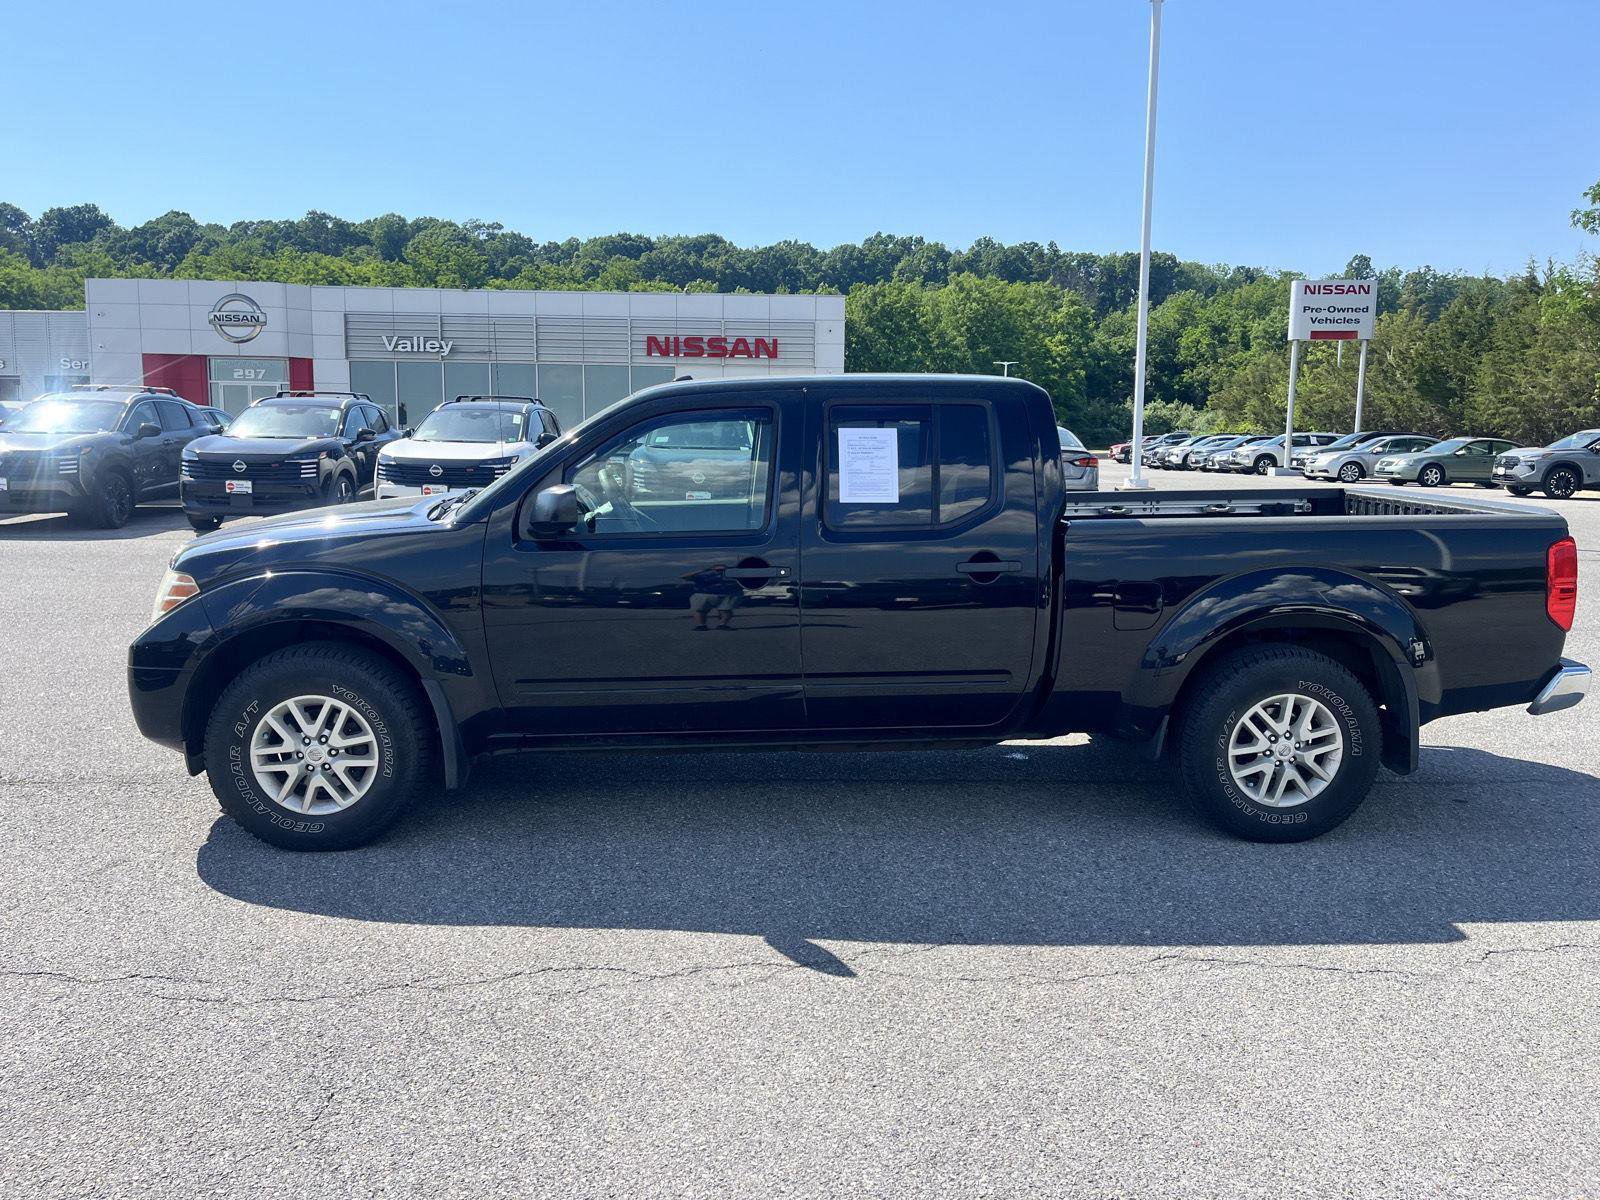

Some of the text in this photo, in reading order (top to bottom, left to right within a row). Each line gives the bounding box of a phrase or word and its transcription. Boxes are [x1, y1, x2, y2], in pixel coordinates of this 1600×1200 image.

[1304, 284, 1371, 295] NISSAN
[213, 314, 260, 323] NISSAN
[1303, 305, 1369, 314] Pre-Owned
[1310, 316, 1361, 325] Vehicles
[381, 335, 454, 356] Valley
[646, 335, 778, 359] NISSAN
[233, 368, 266, 380] 297
[1299, 680, 1362, 756] YOKOHAMA
[332, 684, 394, 778] YOKOHAMA
[230, 700, 325, 833] GEOLANDAR A/T
[1216, 757, 1308, 824] GEOLANDAR
